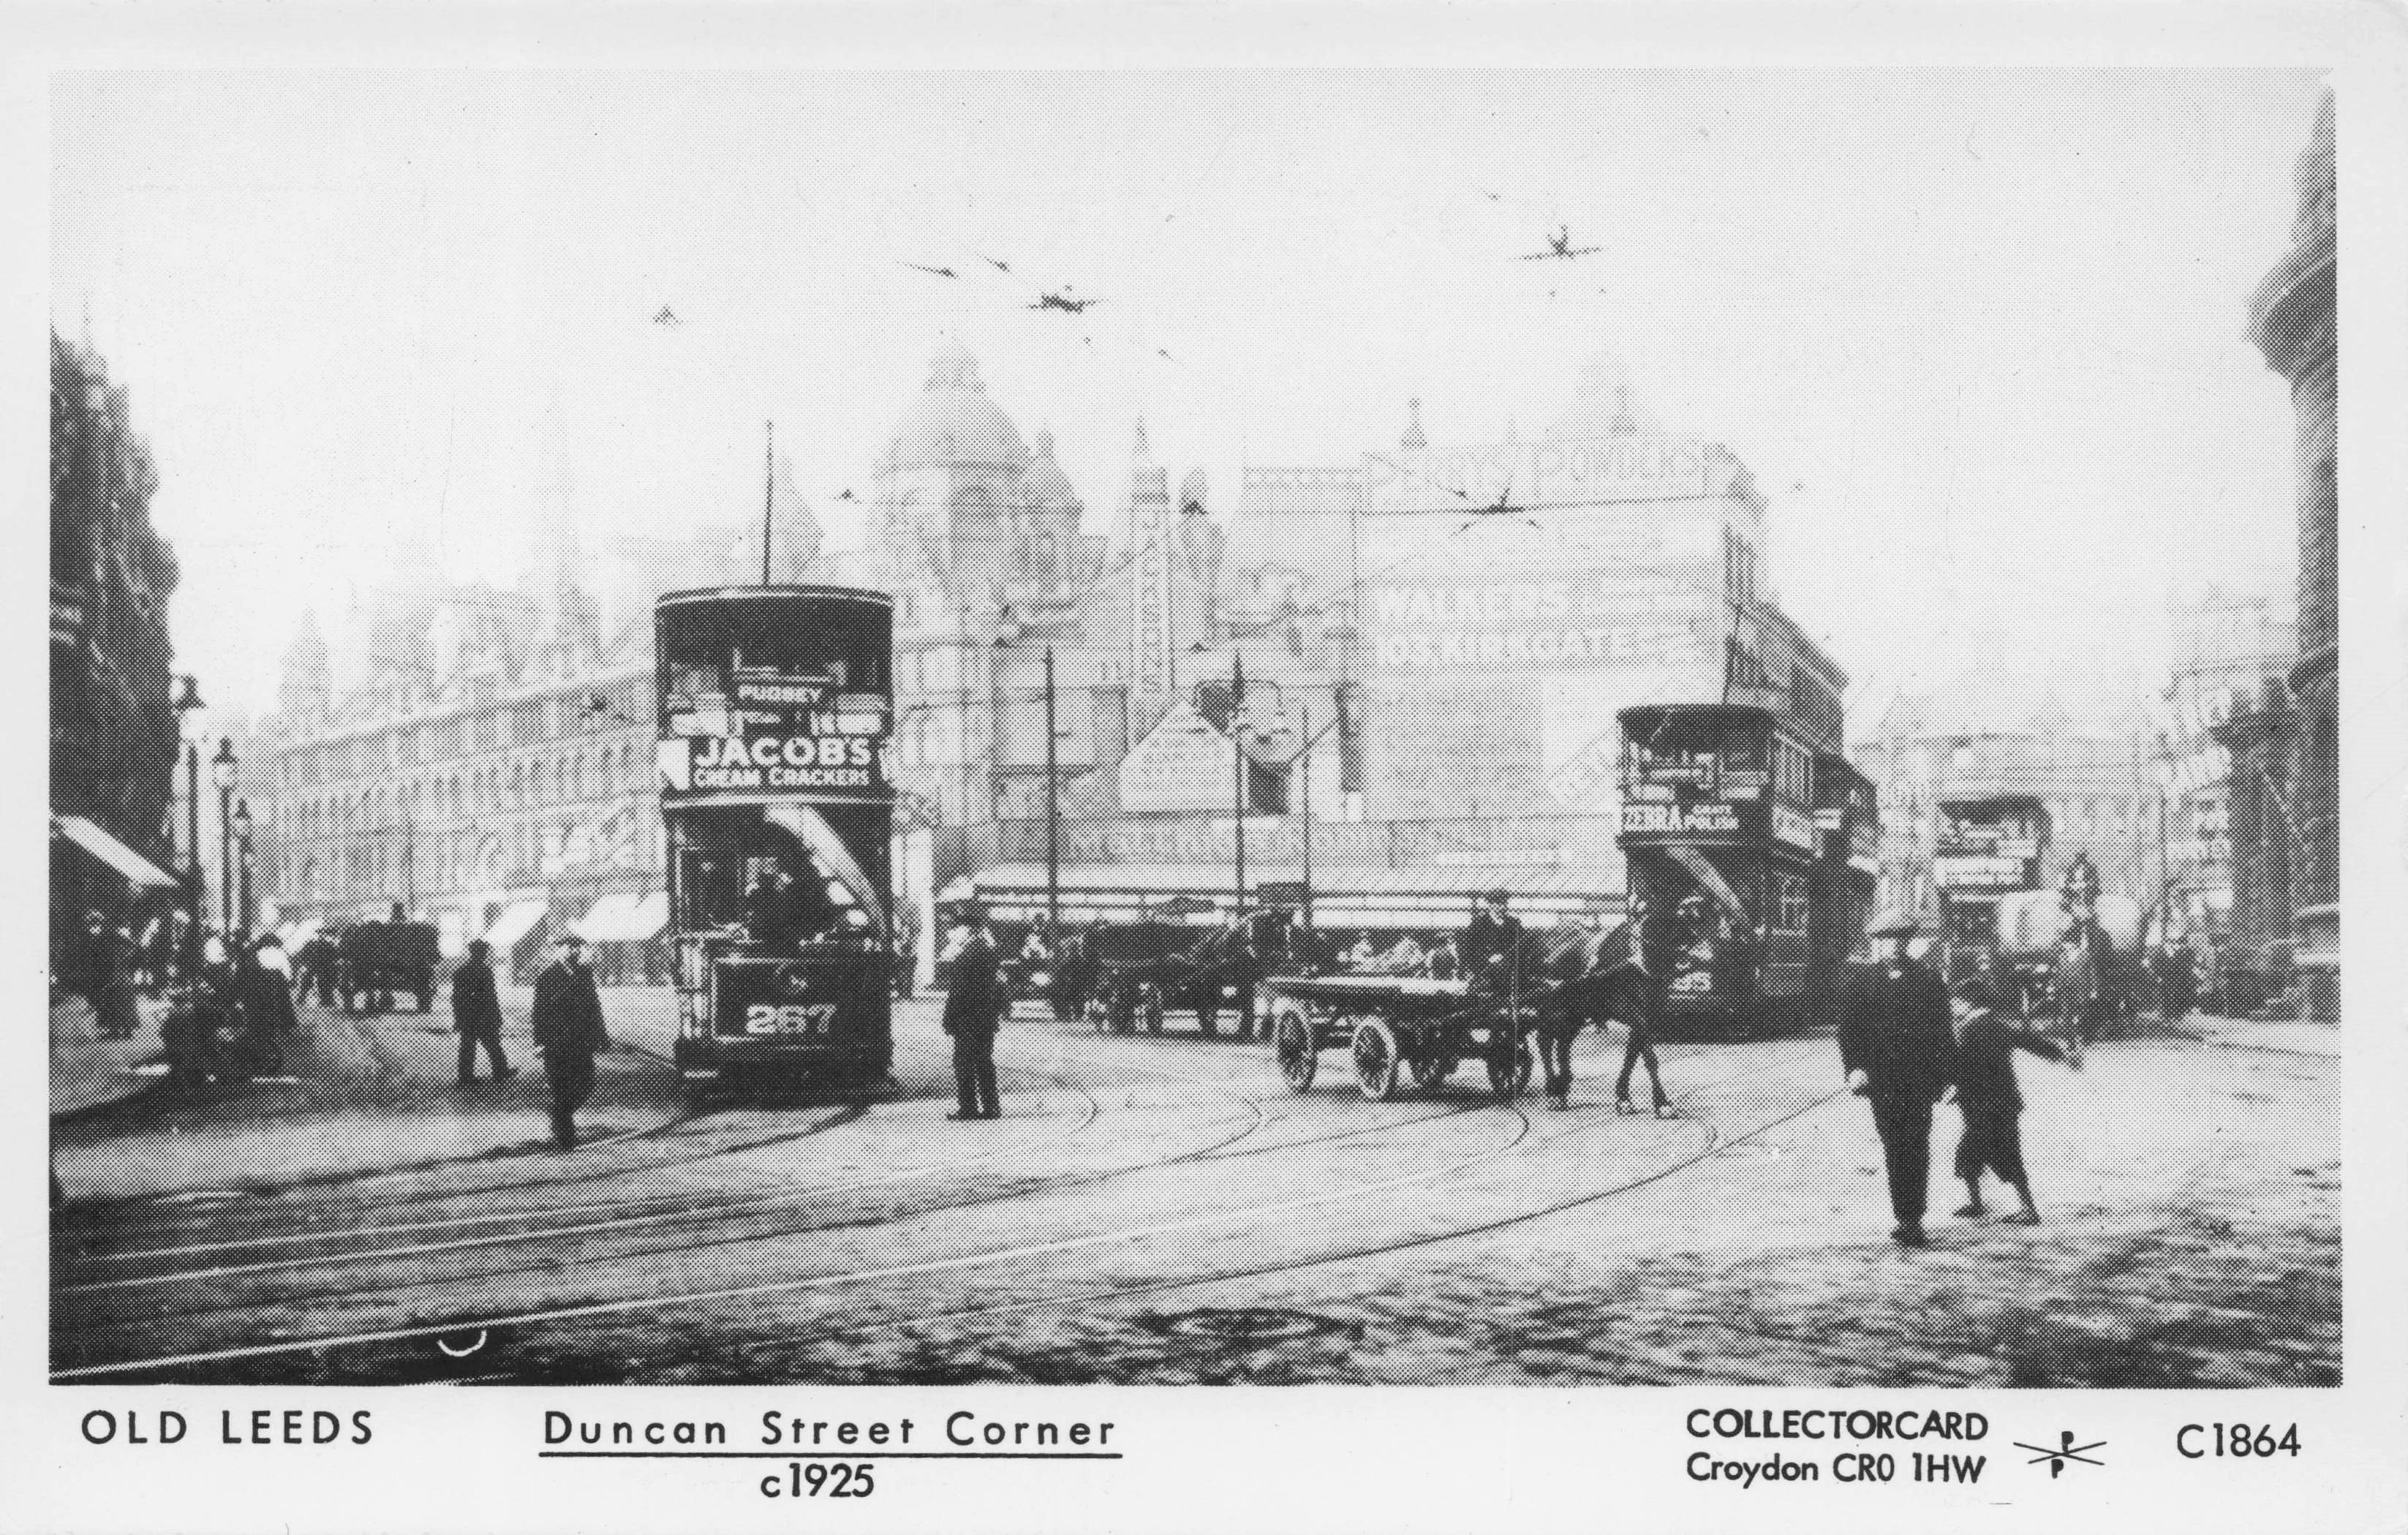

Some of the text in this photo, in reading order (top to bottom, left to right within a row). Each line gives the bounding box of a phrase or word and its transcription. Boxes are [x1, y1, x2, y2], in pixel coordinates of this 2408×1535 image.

[1140, 512, 1163, 695] JACKSONS
[1372, 581, 1570, 623] WALKERS
[695, 736, 872, 767] JACOB'S
[695, 768, 871, 789] CREAM CRACKERS
[746, 1003, 839, 1035] 267
